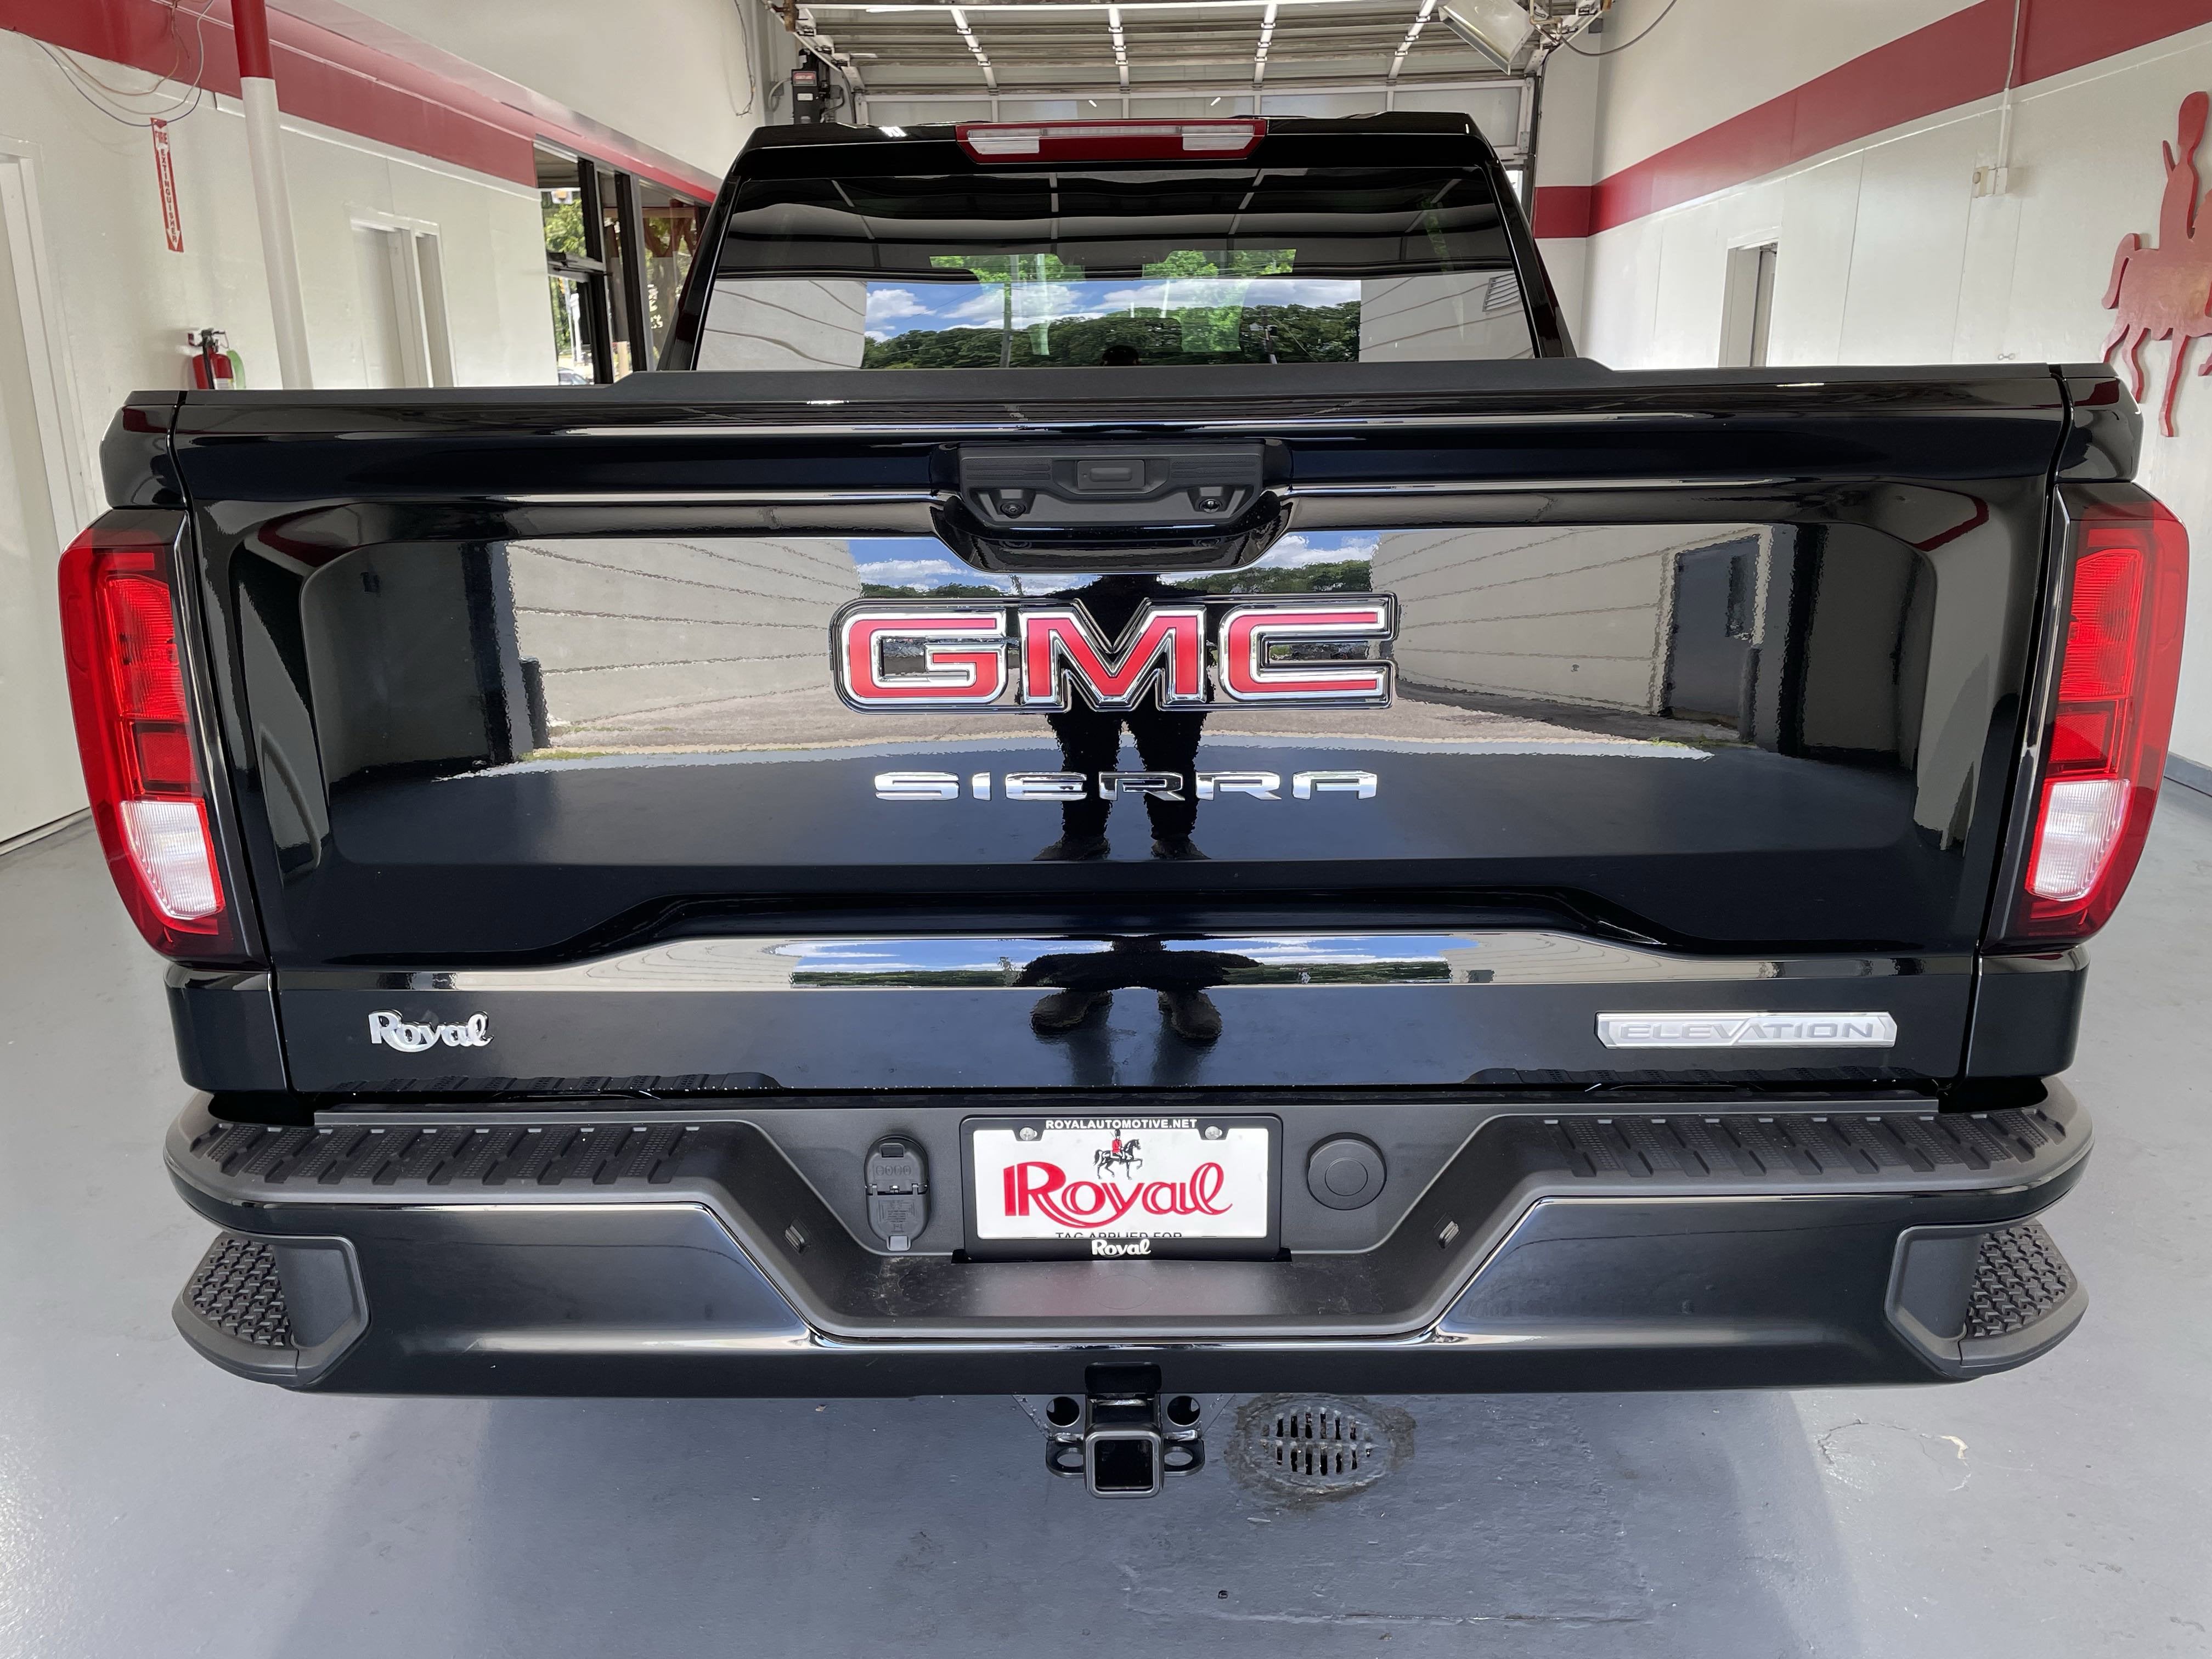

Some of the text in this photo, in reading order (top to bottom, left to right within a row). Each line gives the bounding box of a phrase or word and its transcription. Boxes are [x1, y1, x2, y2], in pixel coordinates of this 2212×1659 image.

[838, 595, 1395, 711] GMC
[874, 771, 1378, 801] SIERRA
[368, 1009, 494, 1053] Royal
[1620, 1022, 1873, 1040] ELEVATION
[1046, 1119, 1197, 1129] ROYALAUTOMOTIVE.NET
[1003, 1162, 1233, 1228] Royal
[1091, 1239, 1152, 1258] Royal
